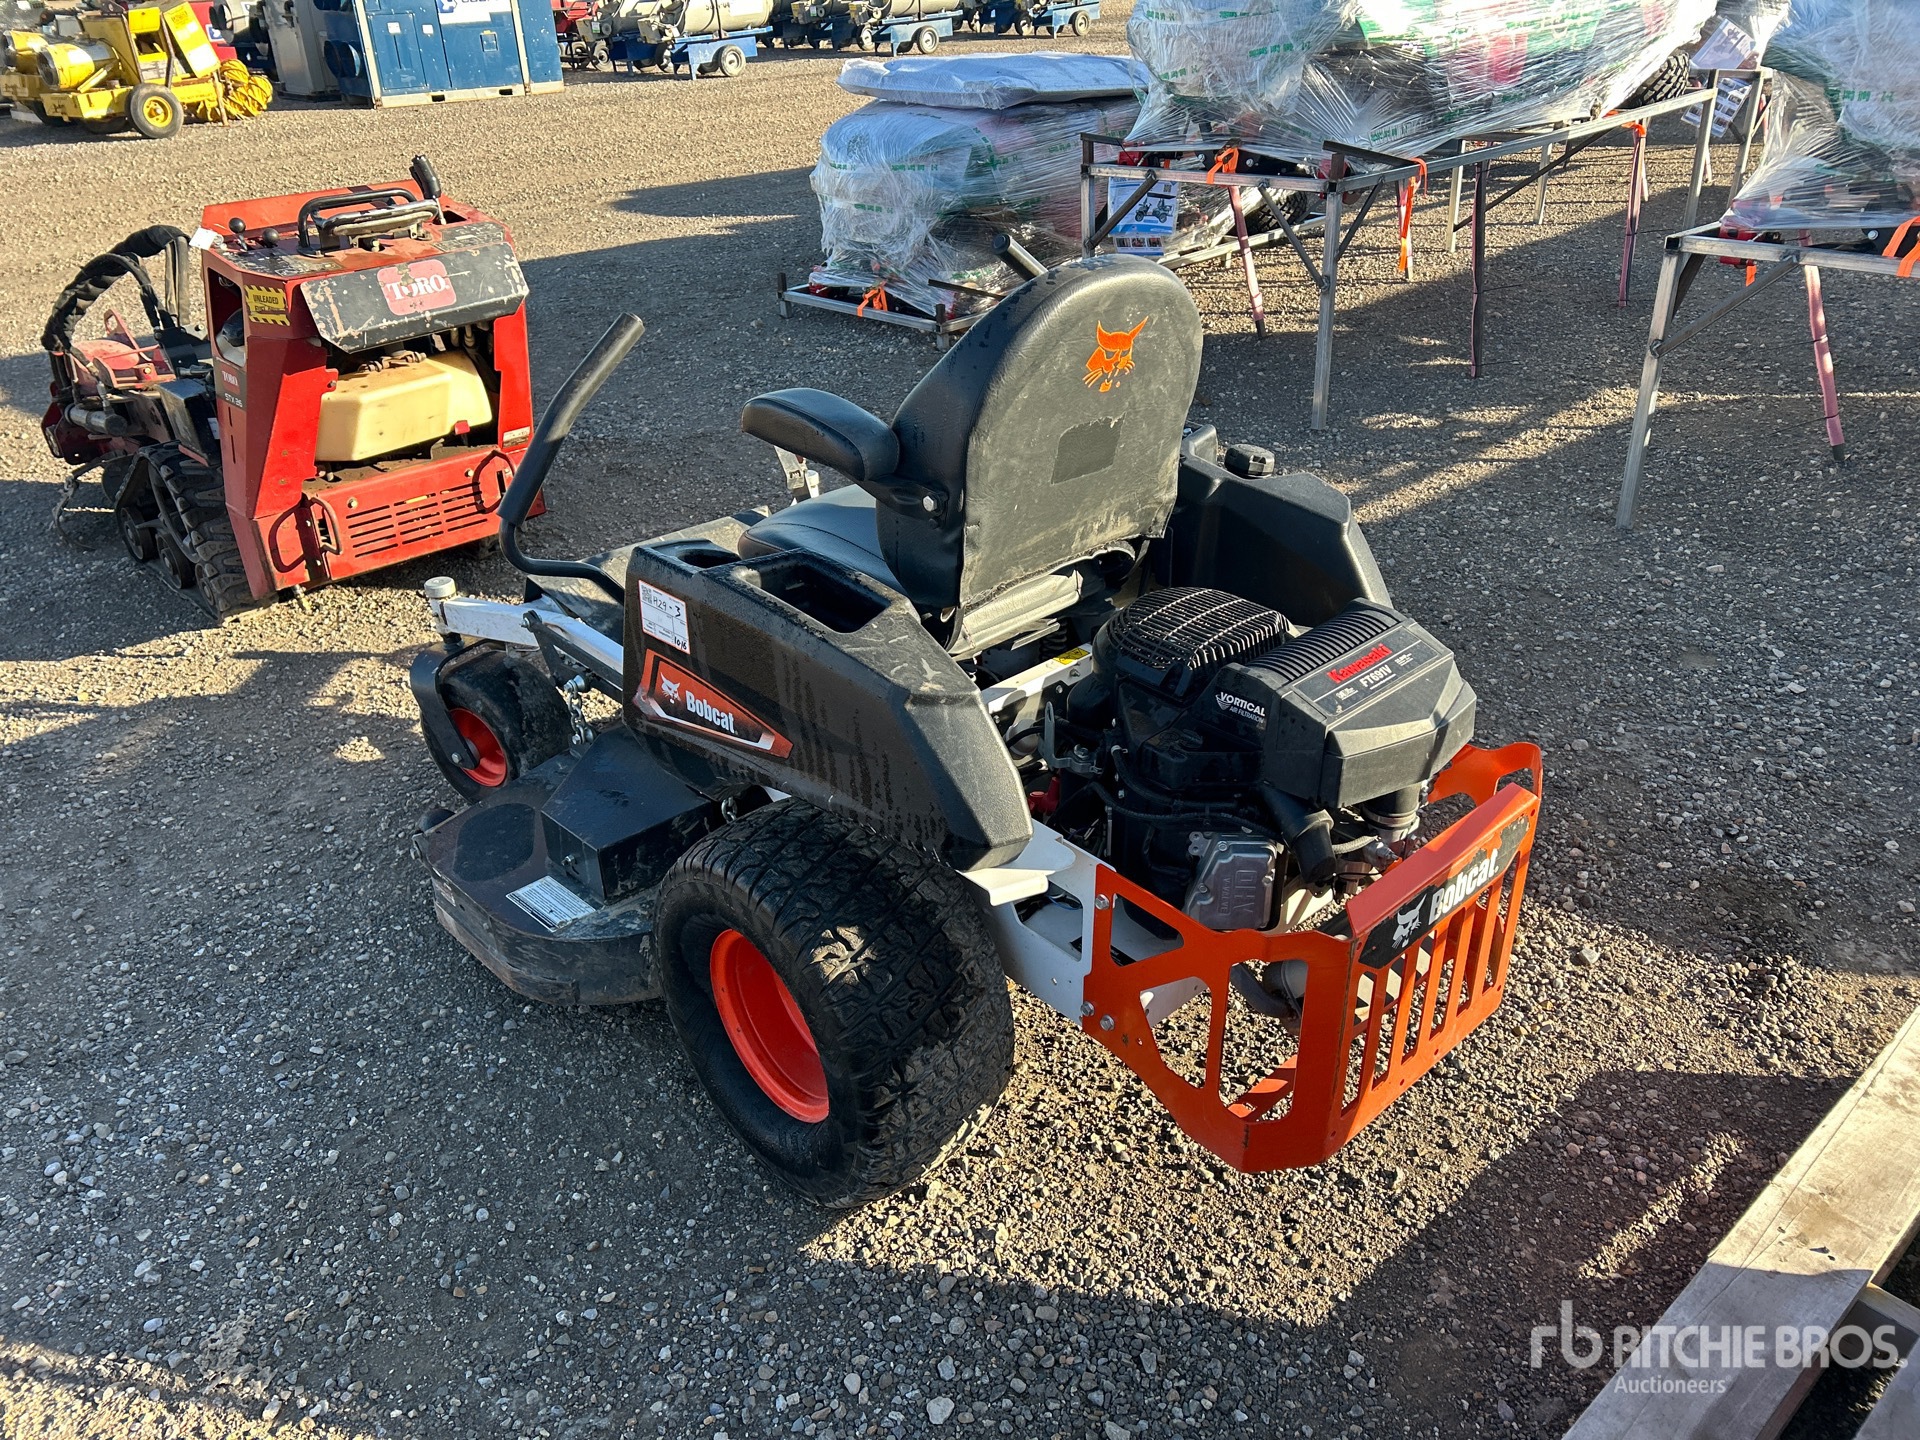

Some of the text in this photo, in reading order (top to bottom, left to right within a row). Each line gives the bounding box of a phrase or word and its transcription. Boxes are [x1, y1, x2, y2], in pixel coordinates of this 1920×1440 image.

[253, 294, 279, 305] UNLEADED
[1326, 643, 1393, 684] Kawasaki
[1359, 664, 1392, 688] FT691V
[685, 690, 736, 734] Bobcat
[1220, 691, 1266, 717] VORTICAL
[1237, 708, 1265, 724] FILTRATION
